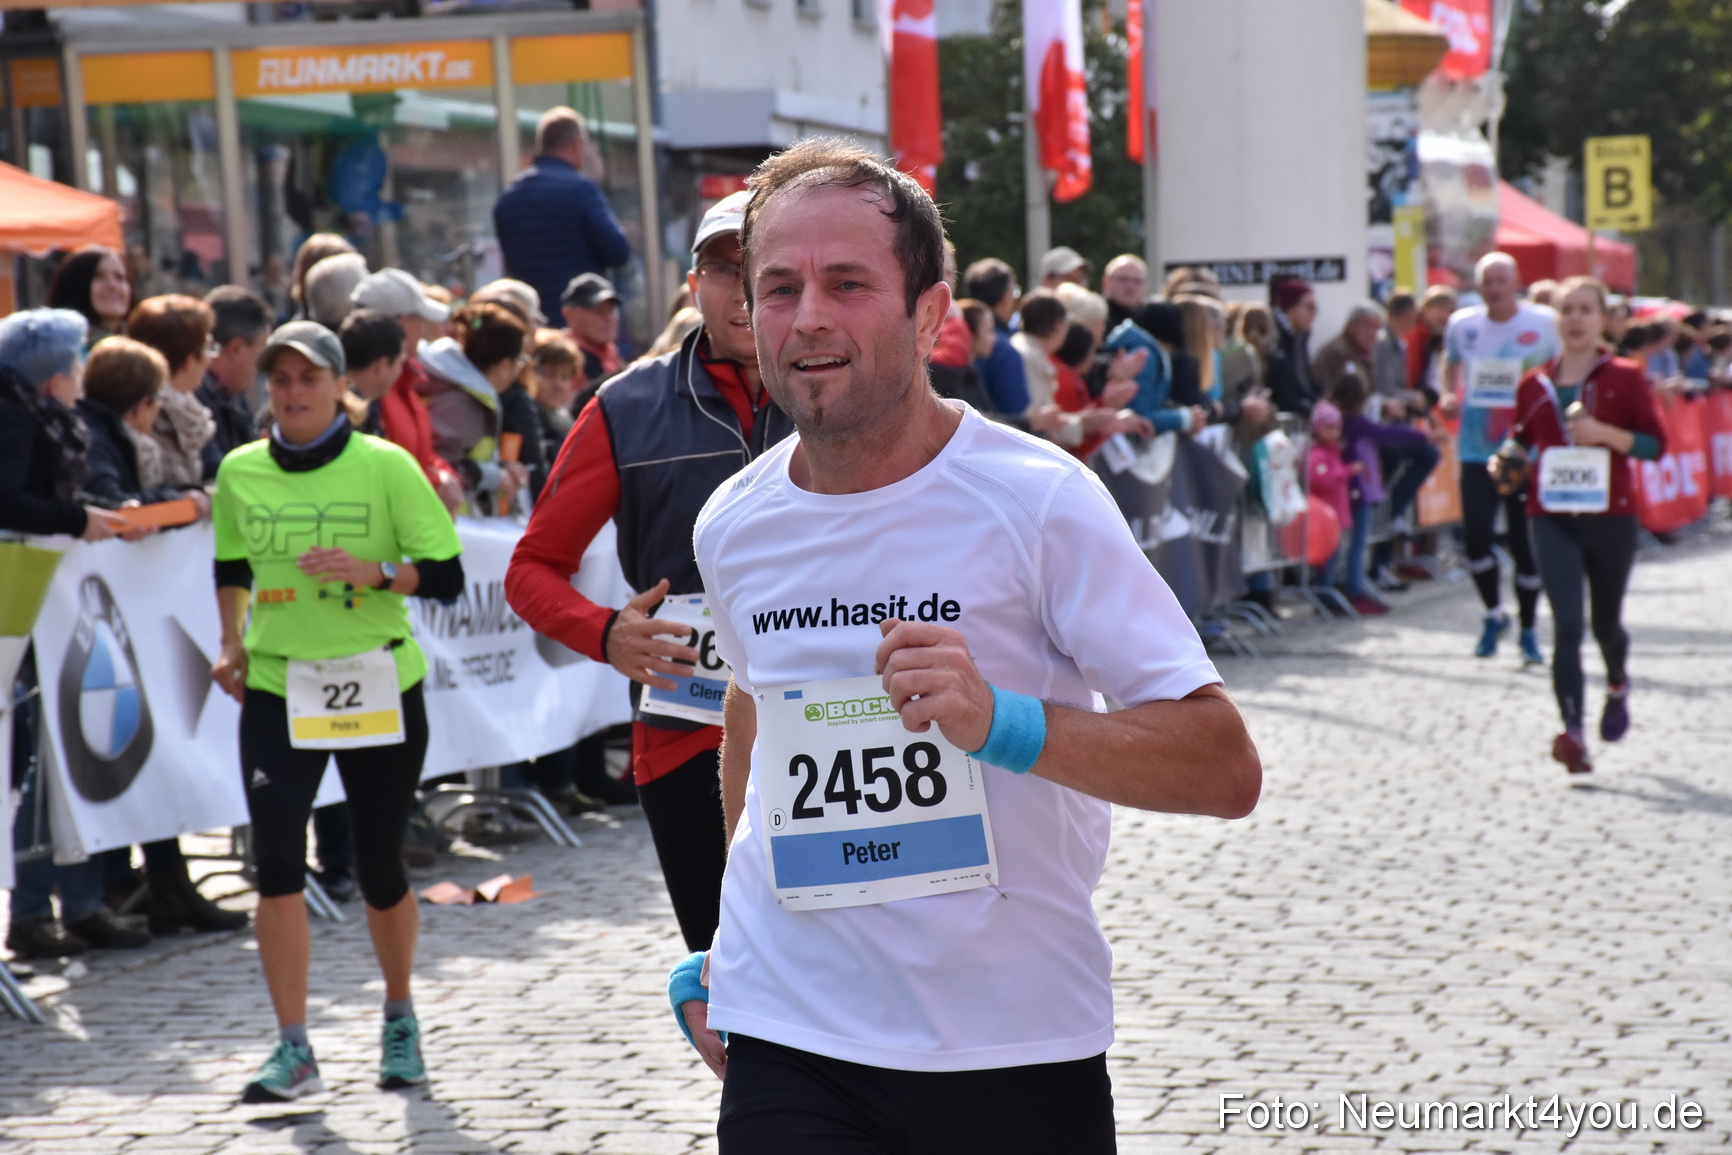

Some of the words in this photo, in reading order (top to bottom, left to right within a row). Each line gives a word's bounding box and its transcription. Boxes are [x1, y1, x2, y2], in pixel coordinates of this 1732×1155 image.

[1604, 166, 1634, 209] B
[752, 592, 961, 635] www.hasit.de
[323, 681, 363, 710] 22
[827, 718, 850, 727] inspired
[851, 718, 859, 726] by
[860, 716, 877, 724] smart
[788, 741, 947, 820] 2458
[774, 814, 781, 826] D
[842, 840, 901, 865] Peter
